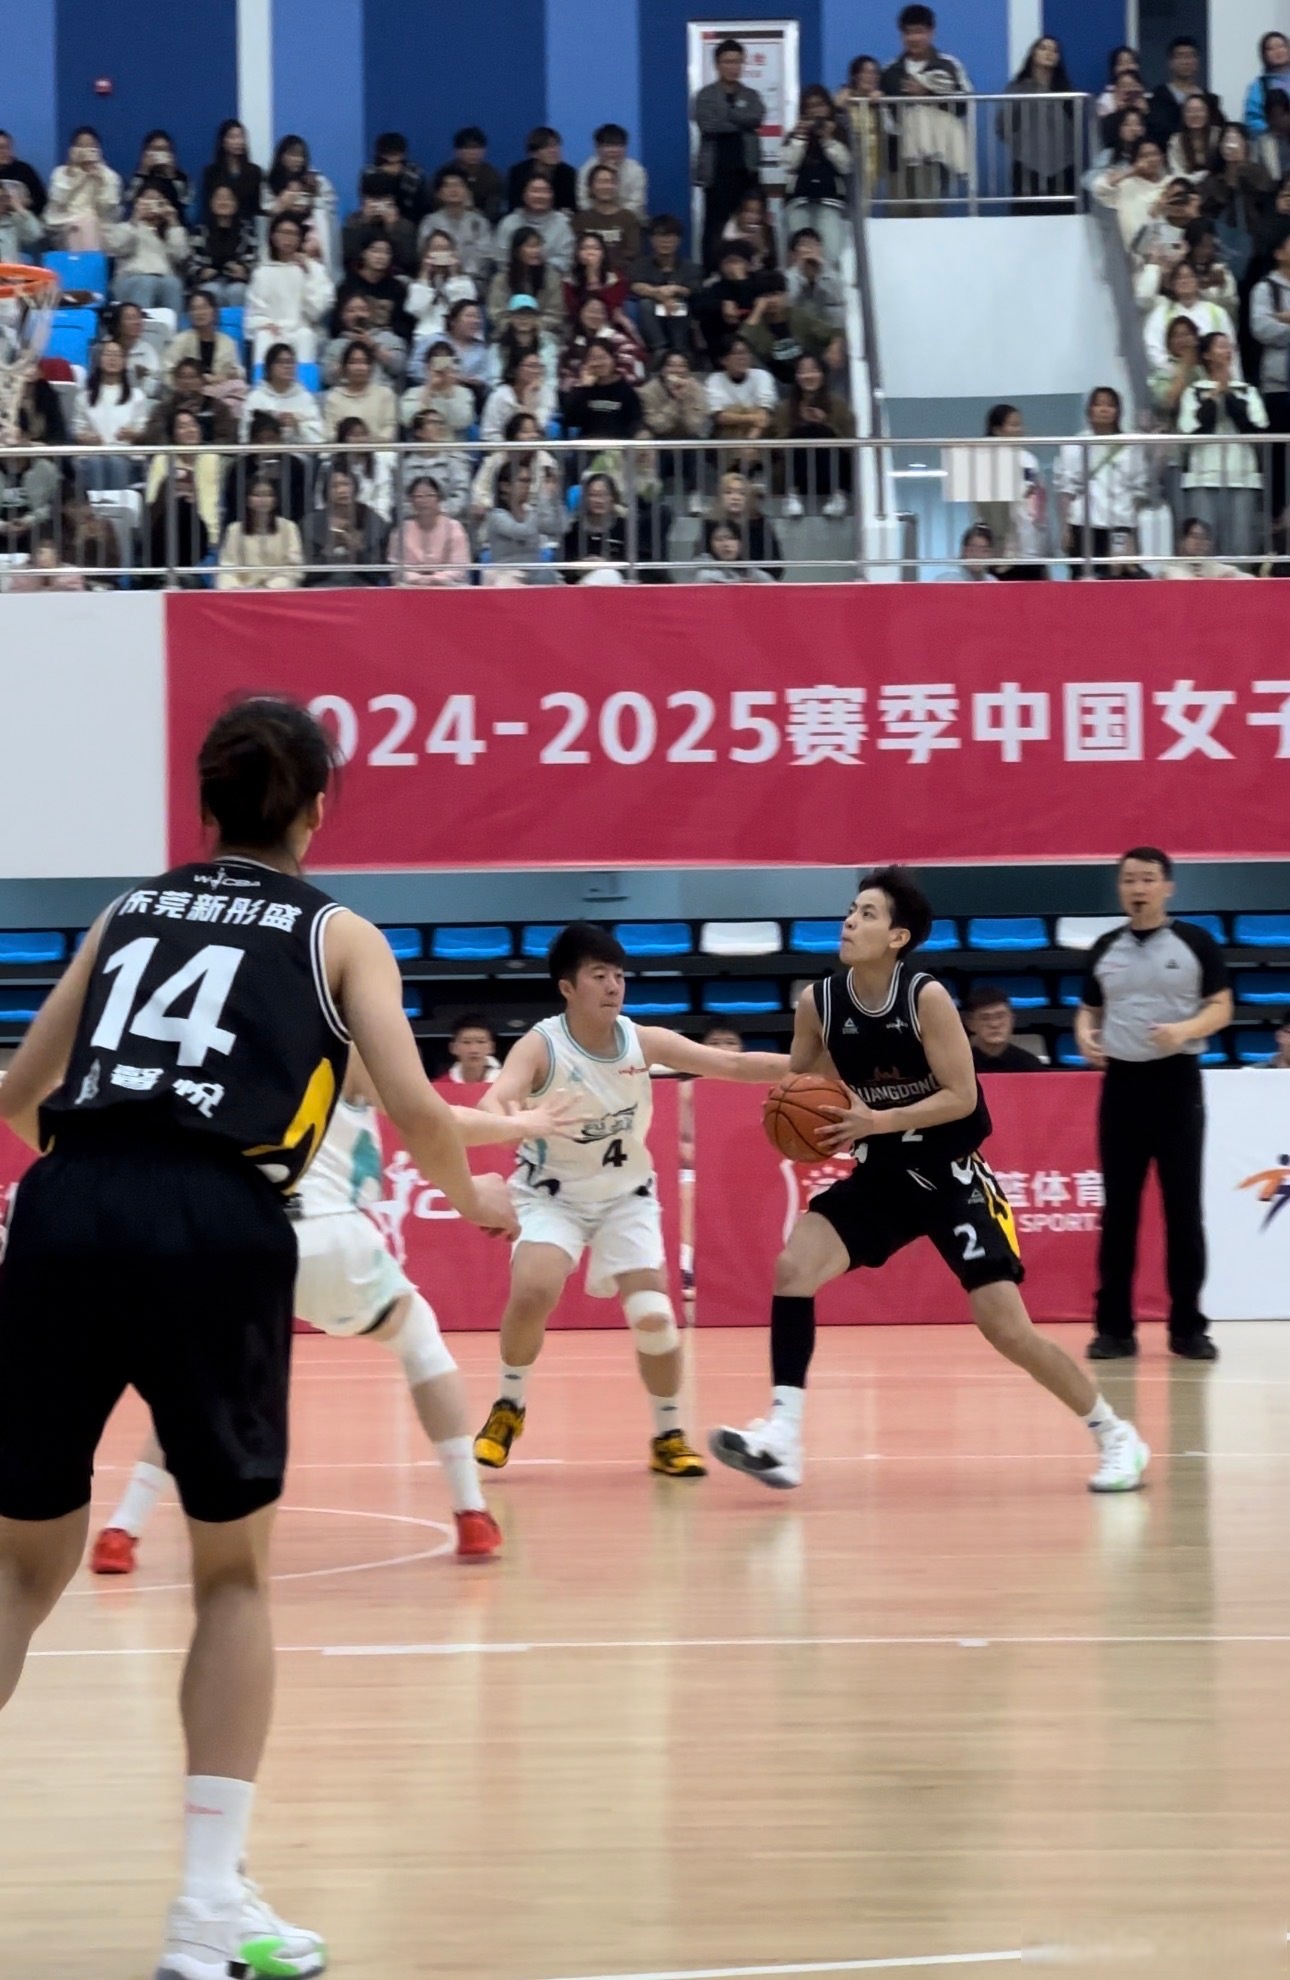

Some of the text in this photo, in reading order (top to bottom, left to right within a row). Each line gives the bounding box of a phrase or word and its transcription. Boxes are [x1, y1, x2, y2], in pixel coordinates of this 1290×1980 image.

[306, 681, 1290, 767] 024-2025赛季中国女子
[117, 889, 304, 934] 东莞新彤盛
[90, 936, 246, 1068] 14
[602, 1139, 628, 1168] 4
[952, 1222, 986, 1262] 2
